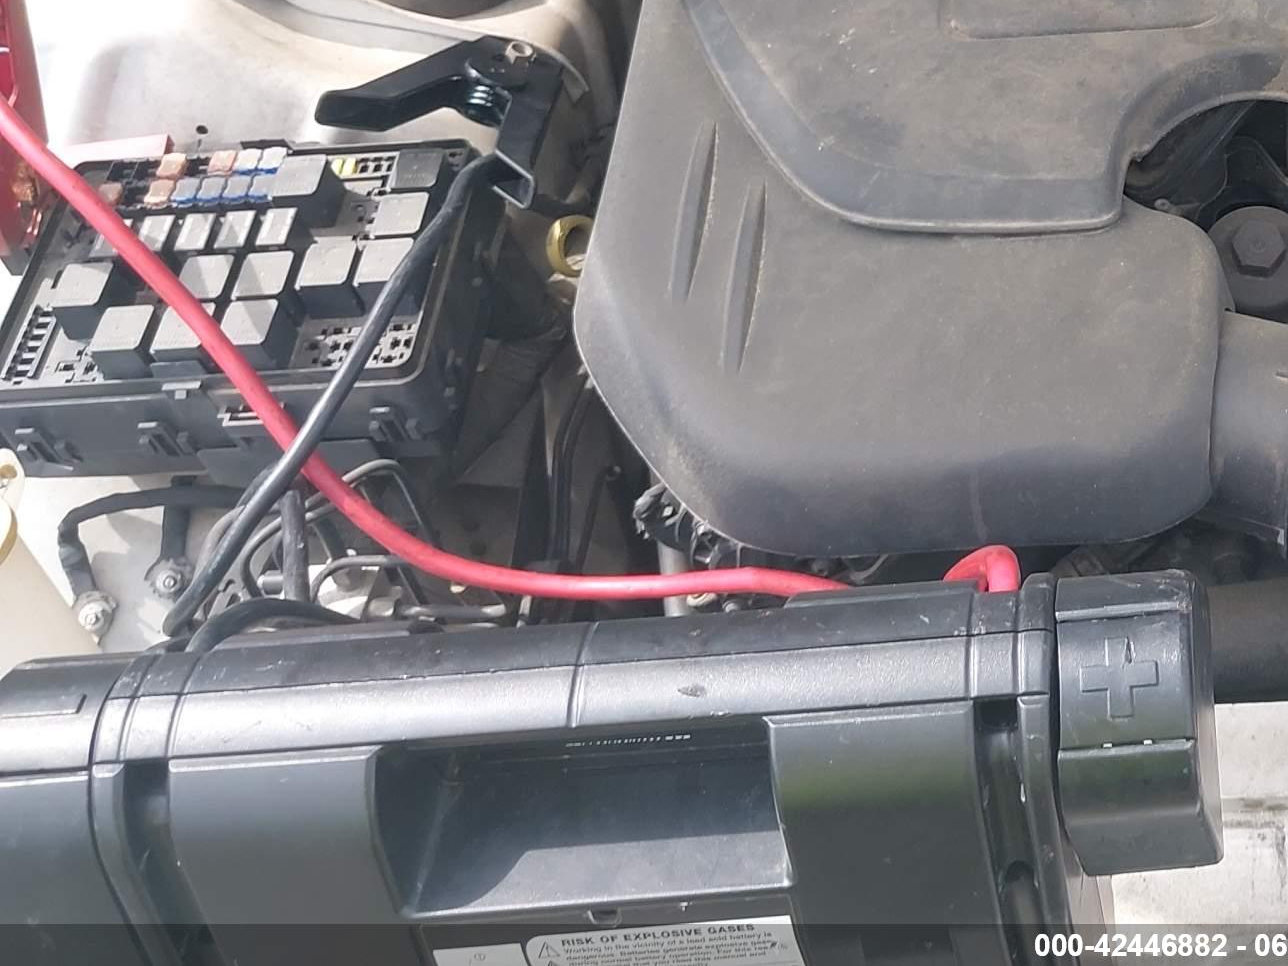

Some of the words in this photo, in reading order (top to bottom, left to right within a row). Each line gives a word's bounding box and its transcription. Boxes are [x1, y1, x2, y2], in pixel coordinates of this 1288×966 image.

[562, 938, 594, 946] RISK
[599, 935, 617, 943] OF
[624, 929, 701, 941] EXPLOSIVE
[708, 924, 754, 934] GASES
[632, 941, 664, 949] vicinity
[729, 933, 761, 941] battery
